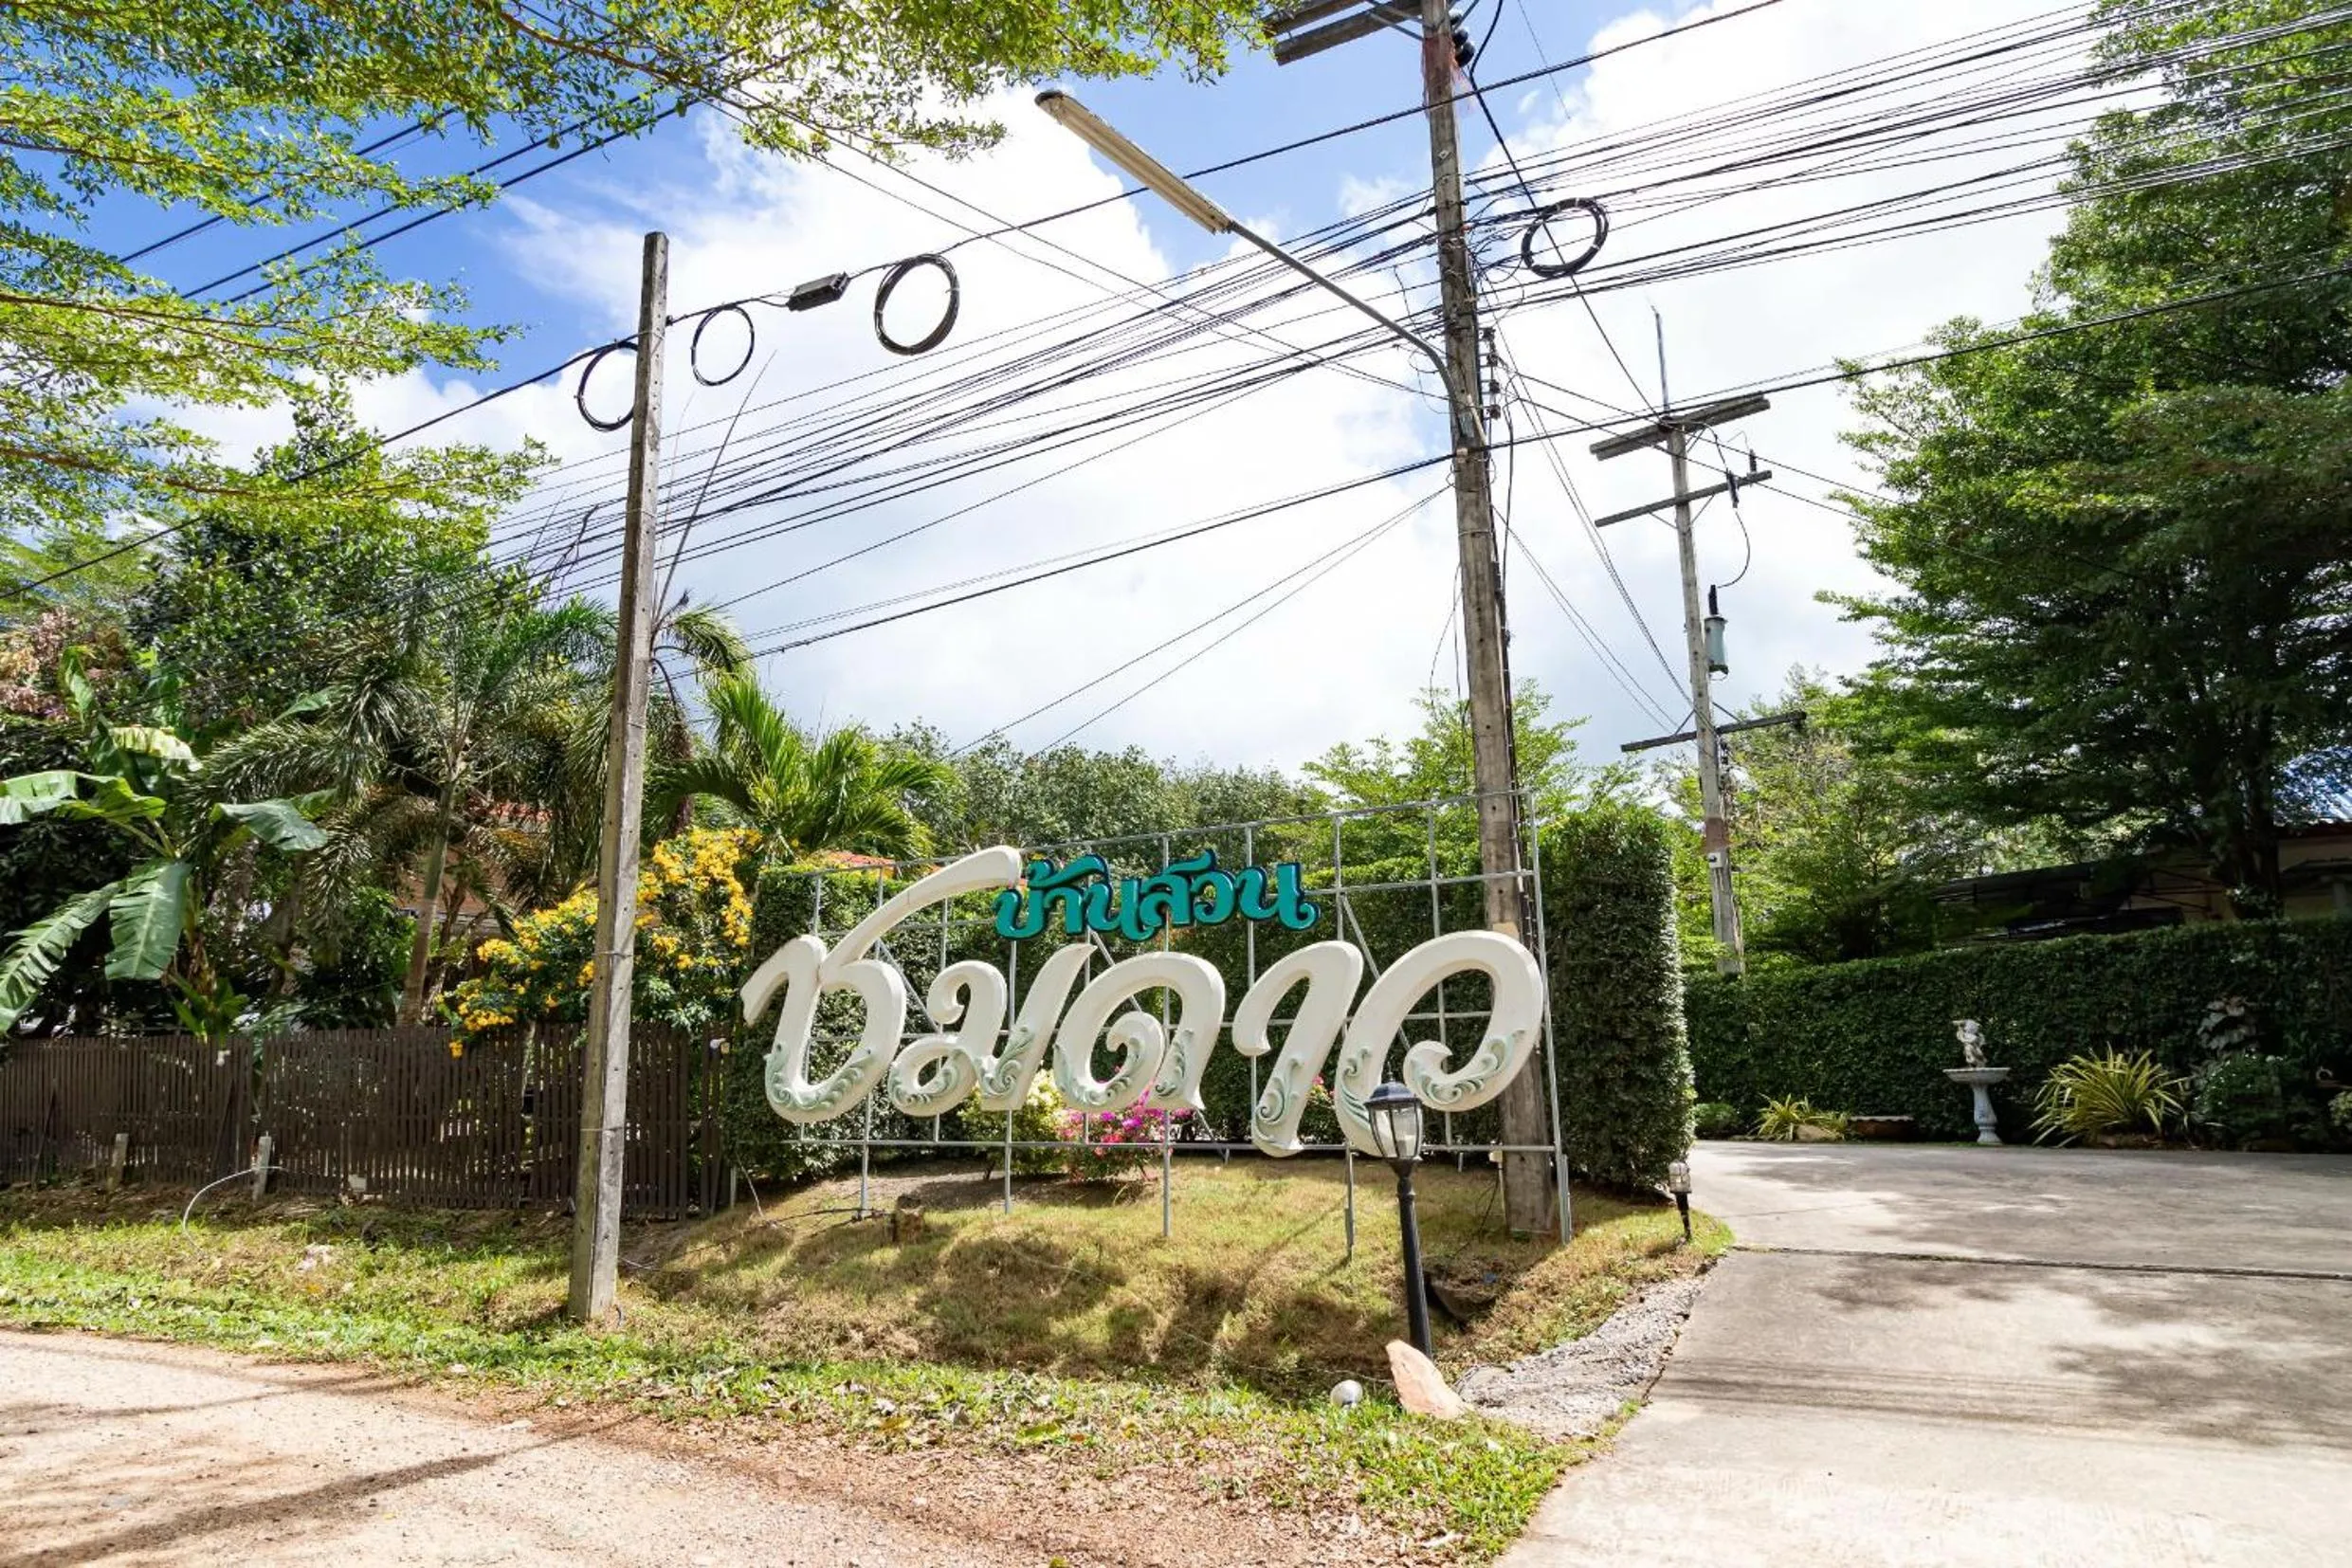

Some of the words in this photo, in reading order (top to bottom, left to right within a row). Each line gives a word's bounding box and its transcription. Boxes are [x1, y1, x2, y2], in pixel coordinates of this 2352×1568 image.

[994, 849, 1320, 940] บ้านสวน
[741, 846, 1543, 1157] ชมดาว
